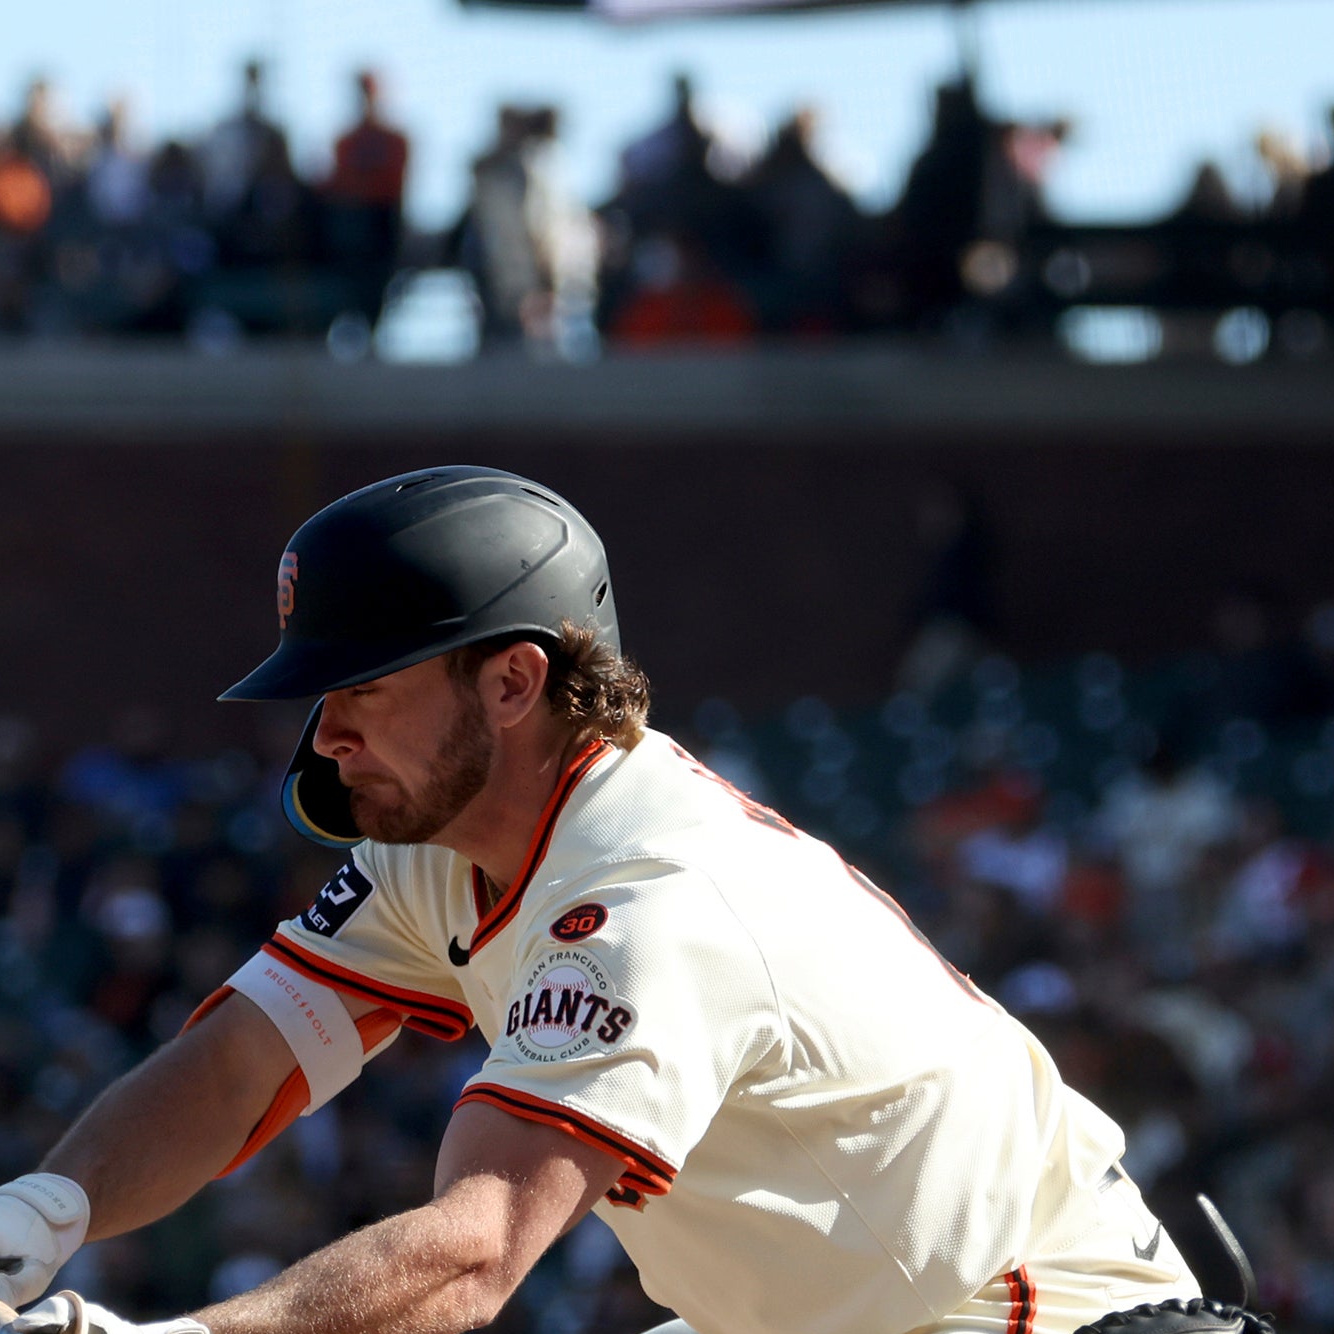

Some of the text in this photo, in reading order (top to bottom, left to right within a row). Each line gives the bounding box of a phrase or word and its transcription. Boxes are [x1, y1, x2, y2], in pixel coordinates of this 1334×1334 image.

[559, 915, 596, 935] 30
[527, 951, 607, 991] SAN FRANCISCO
[264, 968, 333, 1047] BRUCE BOLT
[505, 988, 632, 1045] GIANTS
[515, 1033, 591, 1062] BASEBALL CLUB
